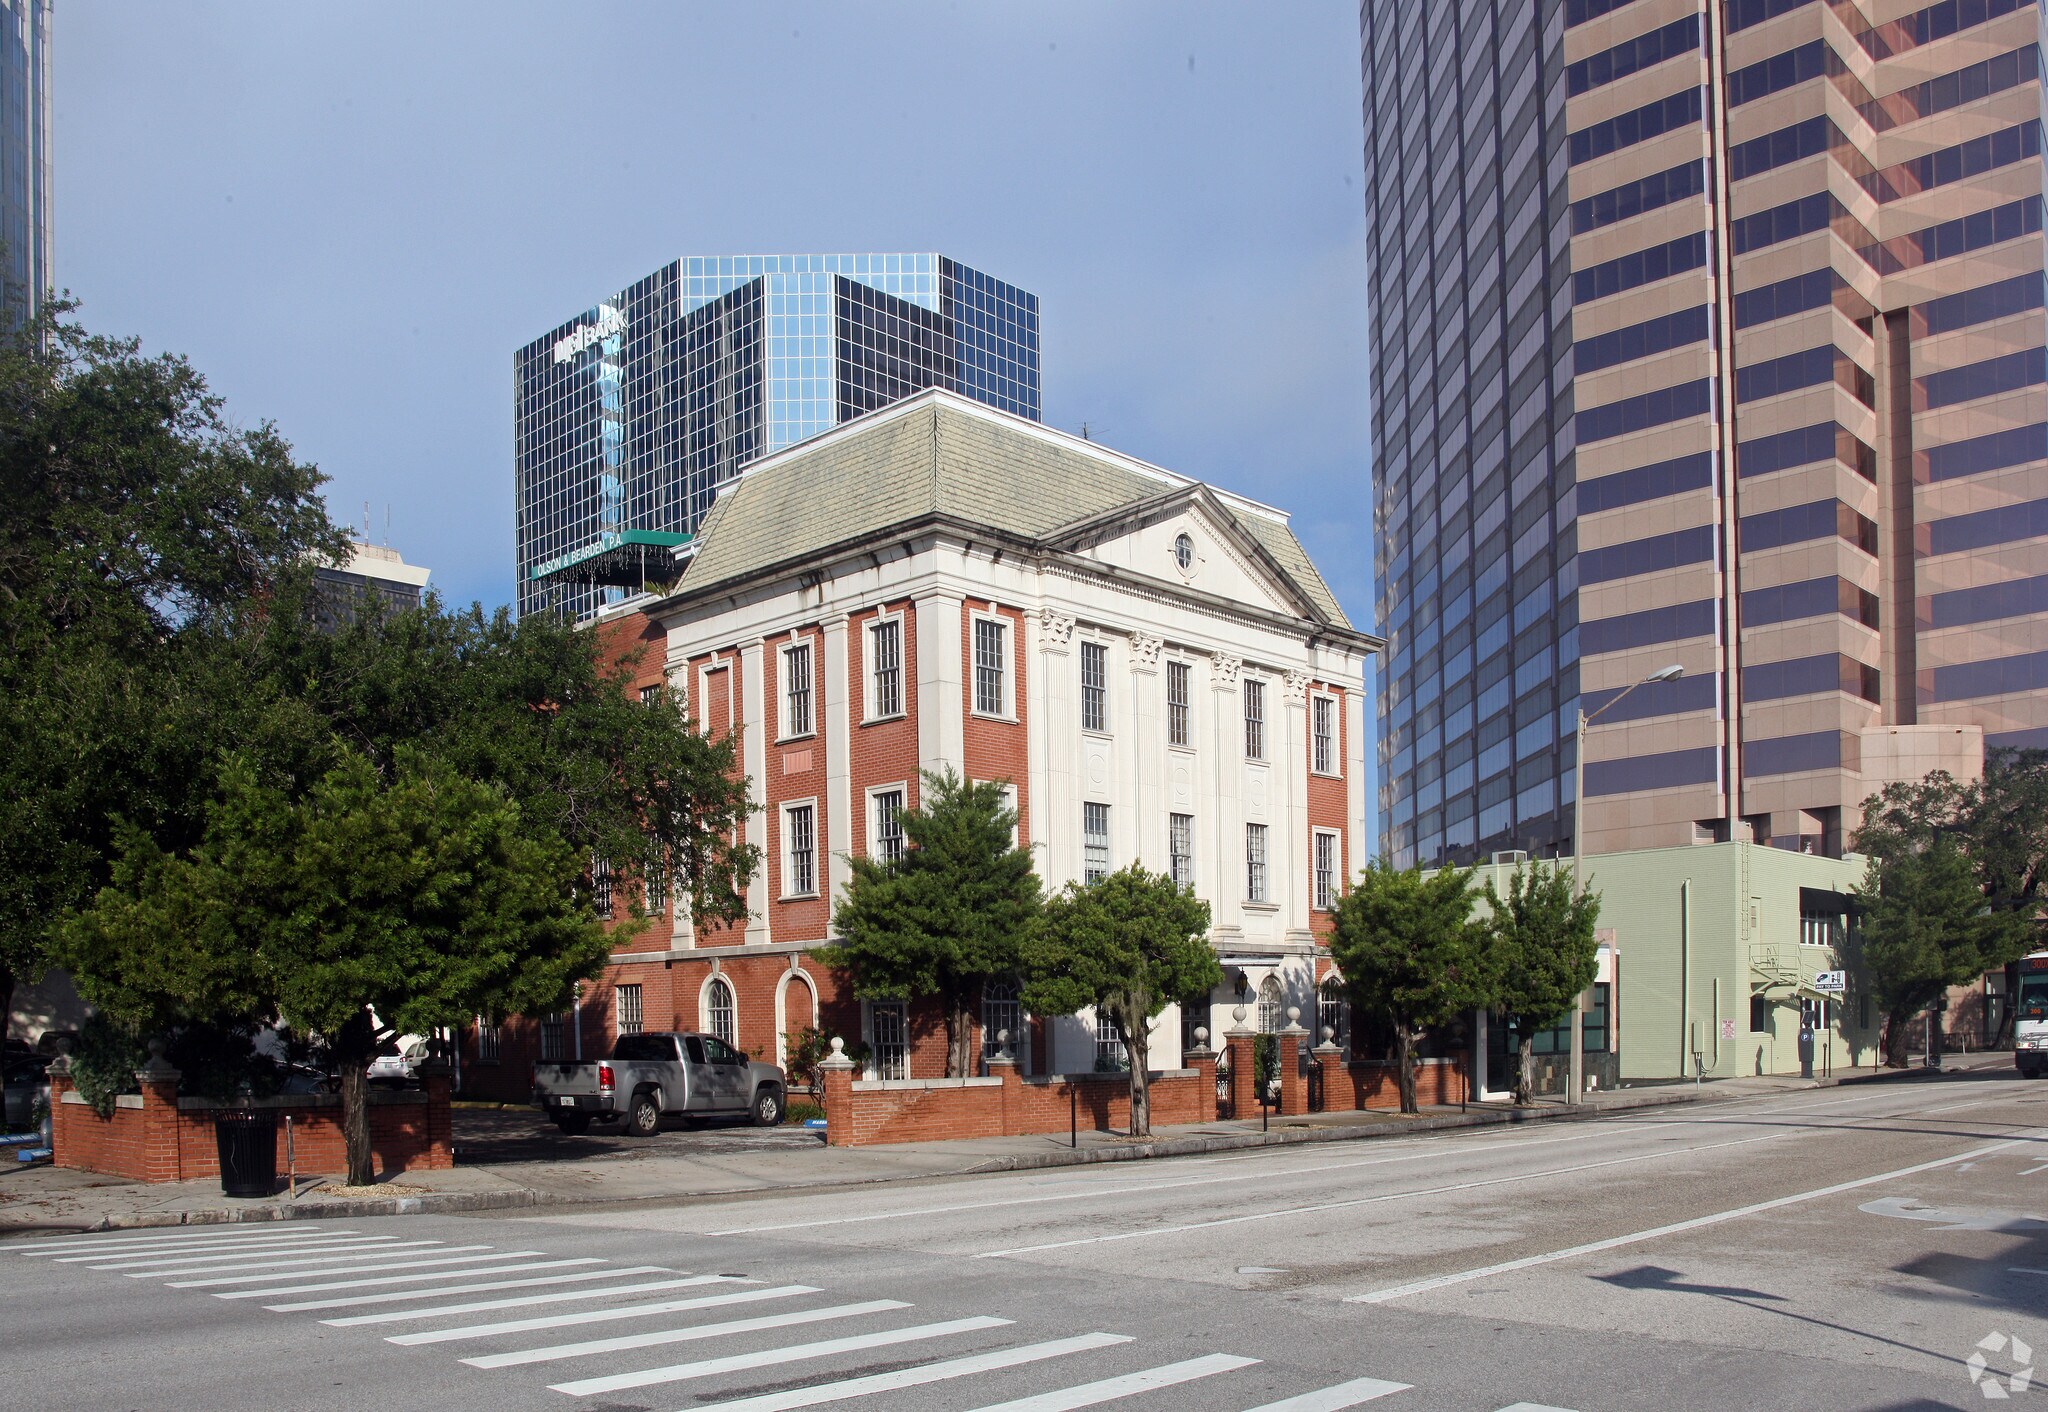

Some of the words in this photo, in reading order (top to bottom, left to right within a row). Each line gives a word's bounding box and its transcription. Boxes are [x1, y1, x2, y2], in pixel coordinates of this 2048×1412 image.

[537, 557, 561, 576] OLSON
[563, 554, 569, 566] &
[609, 533, 623, 549] P.A.
